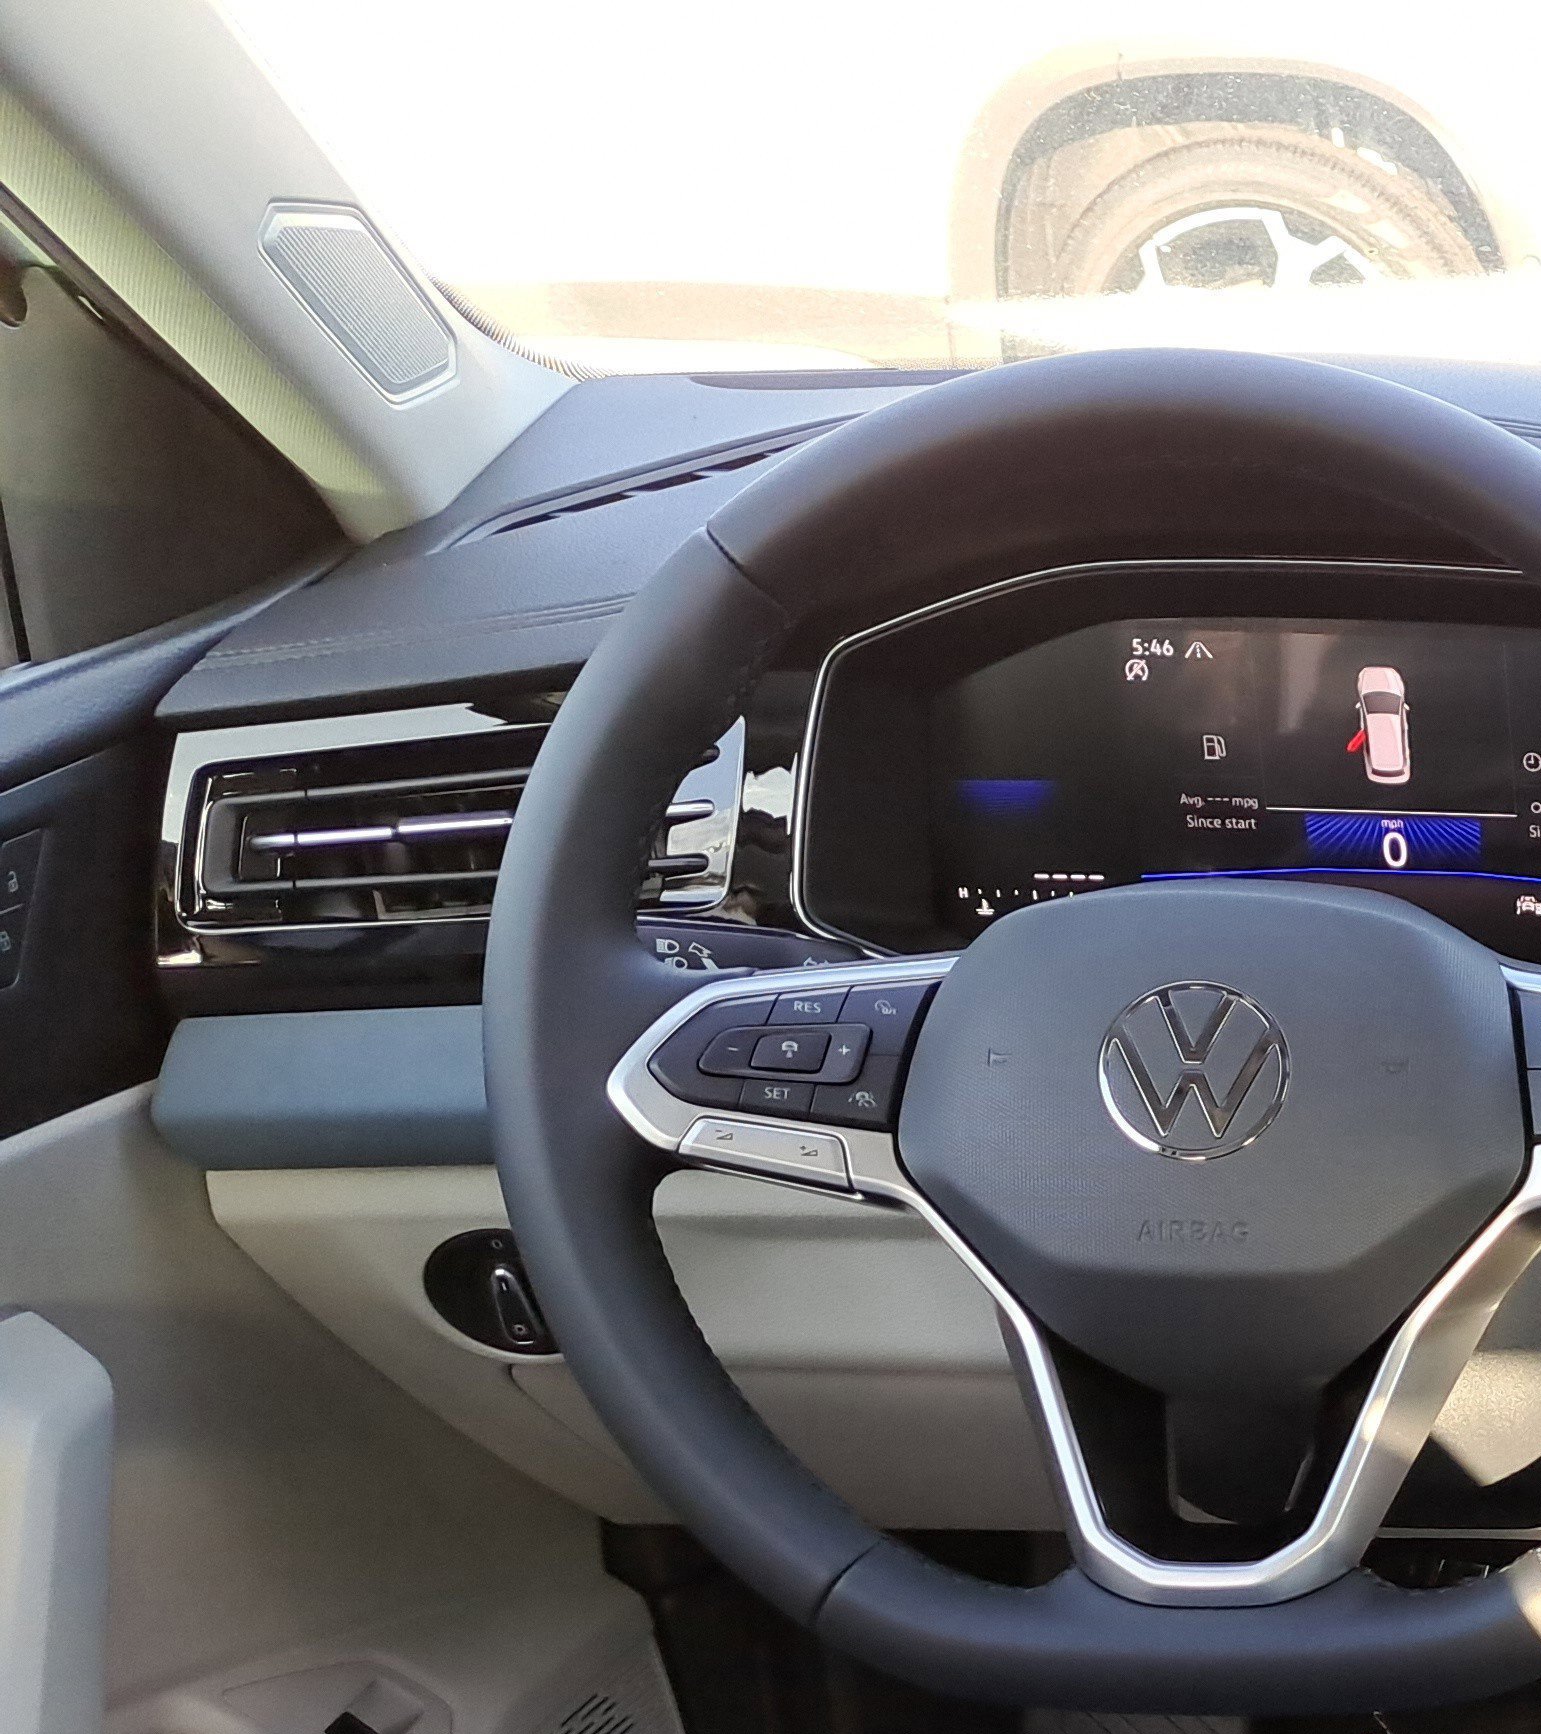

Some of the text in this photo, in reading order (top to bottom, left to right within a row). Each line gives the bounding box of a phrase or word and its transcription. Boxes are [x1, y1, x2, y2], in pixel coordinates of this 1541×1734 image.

[1132, 638, 1174, 656] 5:46
[1232, 797, 1259, 810] mpg
[1186, 815, 1258, 829] Since start
[1382, 832, 1408, 868] 0
[793, 1000, 821, 1014] RES
[763, 1086, 790, 1100] SET
[1137, 1220, 1250, 1242] AIRBAG
